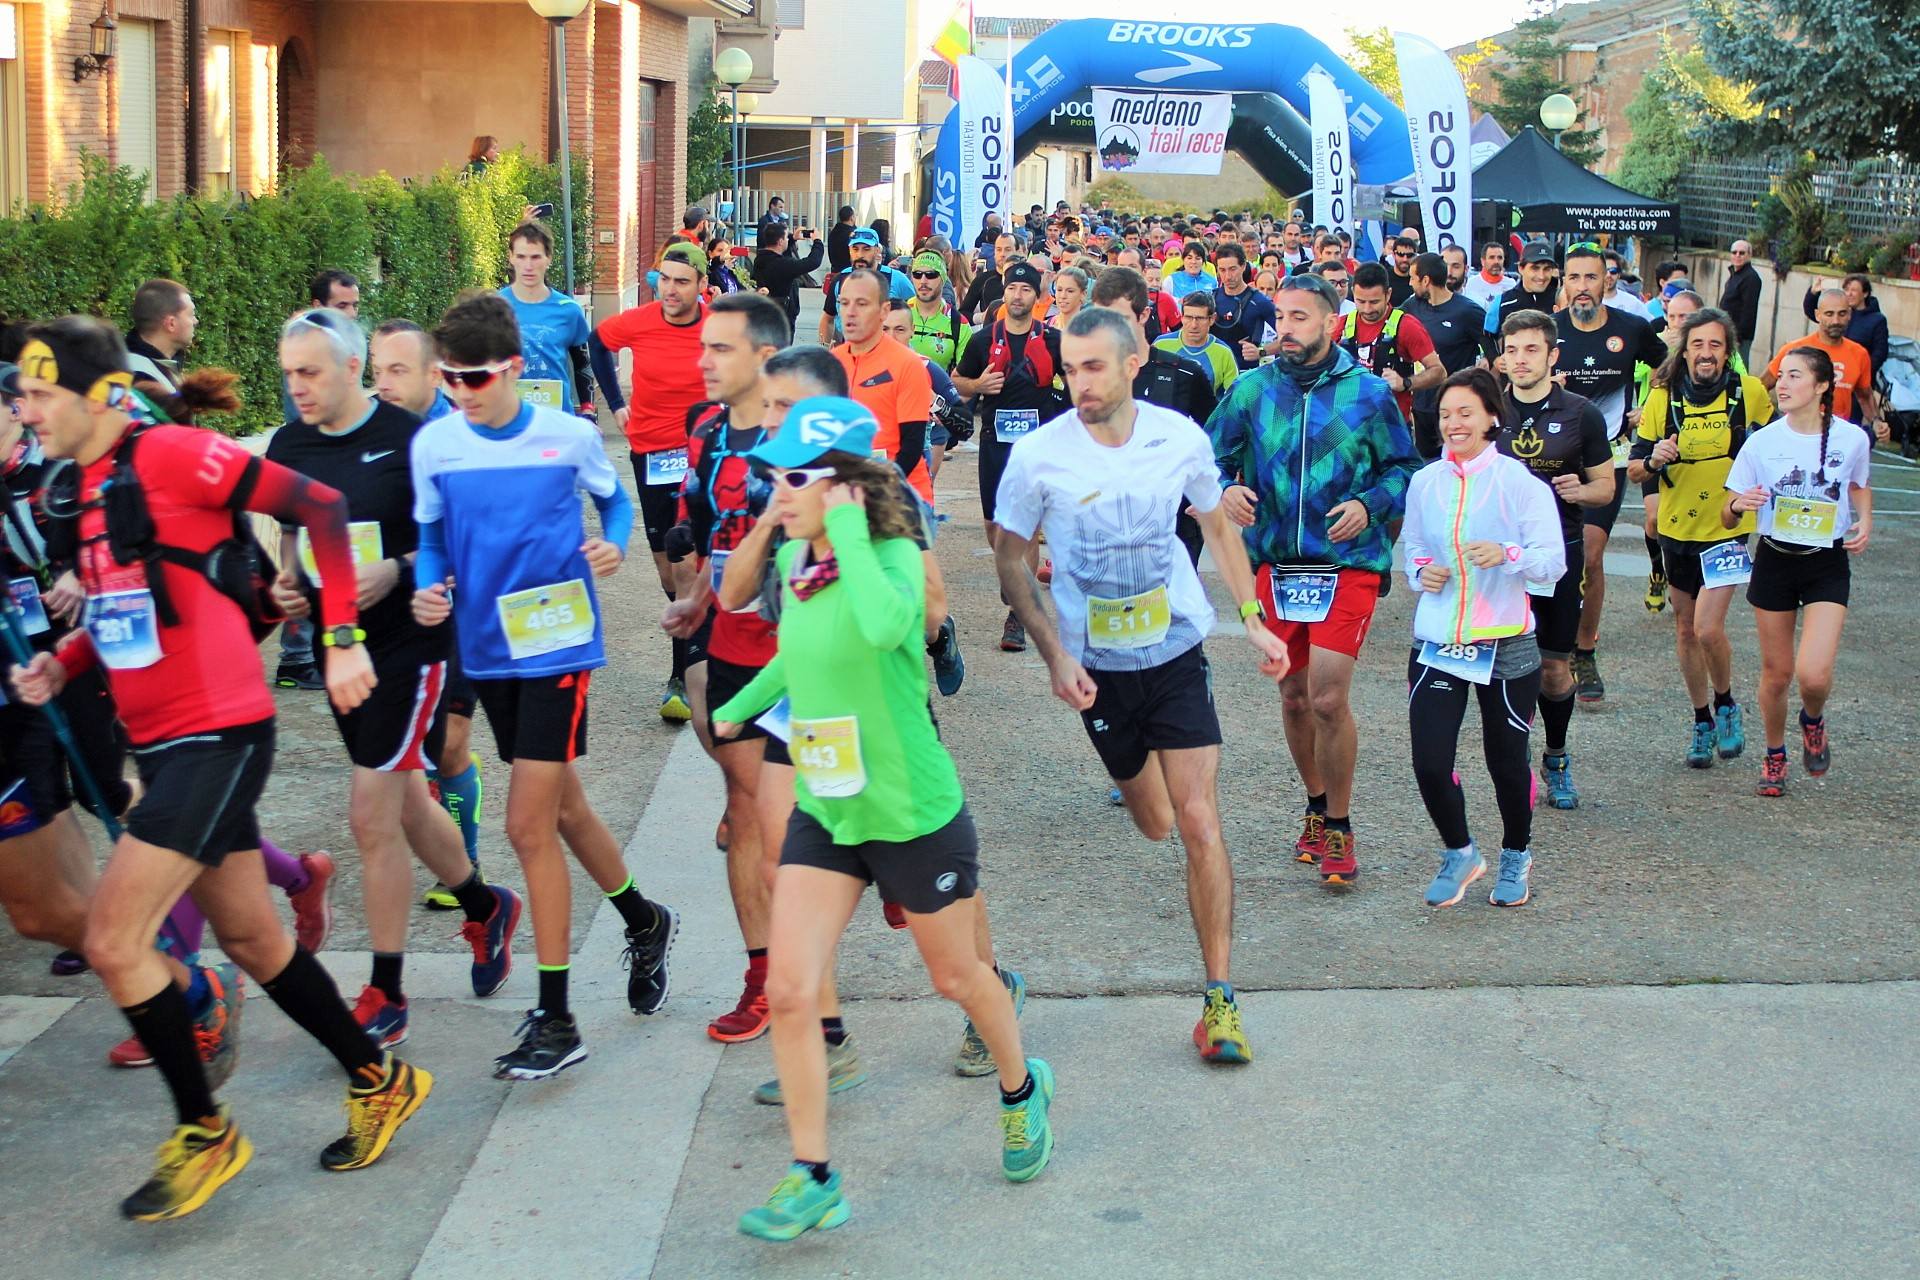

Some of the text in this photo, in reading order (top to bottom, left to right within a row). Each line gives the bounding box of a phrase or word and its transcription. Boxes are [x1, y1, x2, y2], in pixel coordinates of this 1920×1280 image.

[1107, 22, 1256, 48] BROOKS
[1110, 94, 1203, 126] medrano
[1149, 127, 1225, 154] trail race
[934, 167, 957, 239] OKS
[1566, 206, 1671, 219] www.podoactiva.com
[1578, 219, 1658, 231] Tel. 902 365 099
[1581, 368, 1591, 376] los
[525, 391, 551, 403] 503
[1004, 420, 1030, 432] 229
[660, 457, 688, 472] 228
[1788, 513, 1824, 530] 437
[1715, 554, 1744, 572] 227
[1286, 588, 1322, 605] 242
[526, 603, 575, 630] 465
[1108, 610, 1152, 632] 511
[1436, 643, 1479, 662] 289
